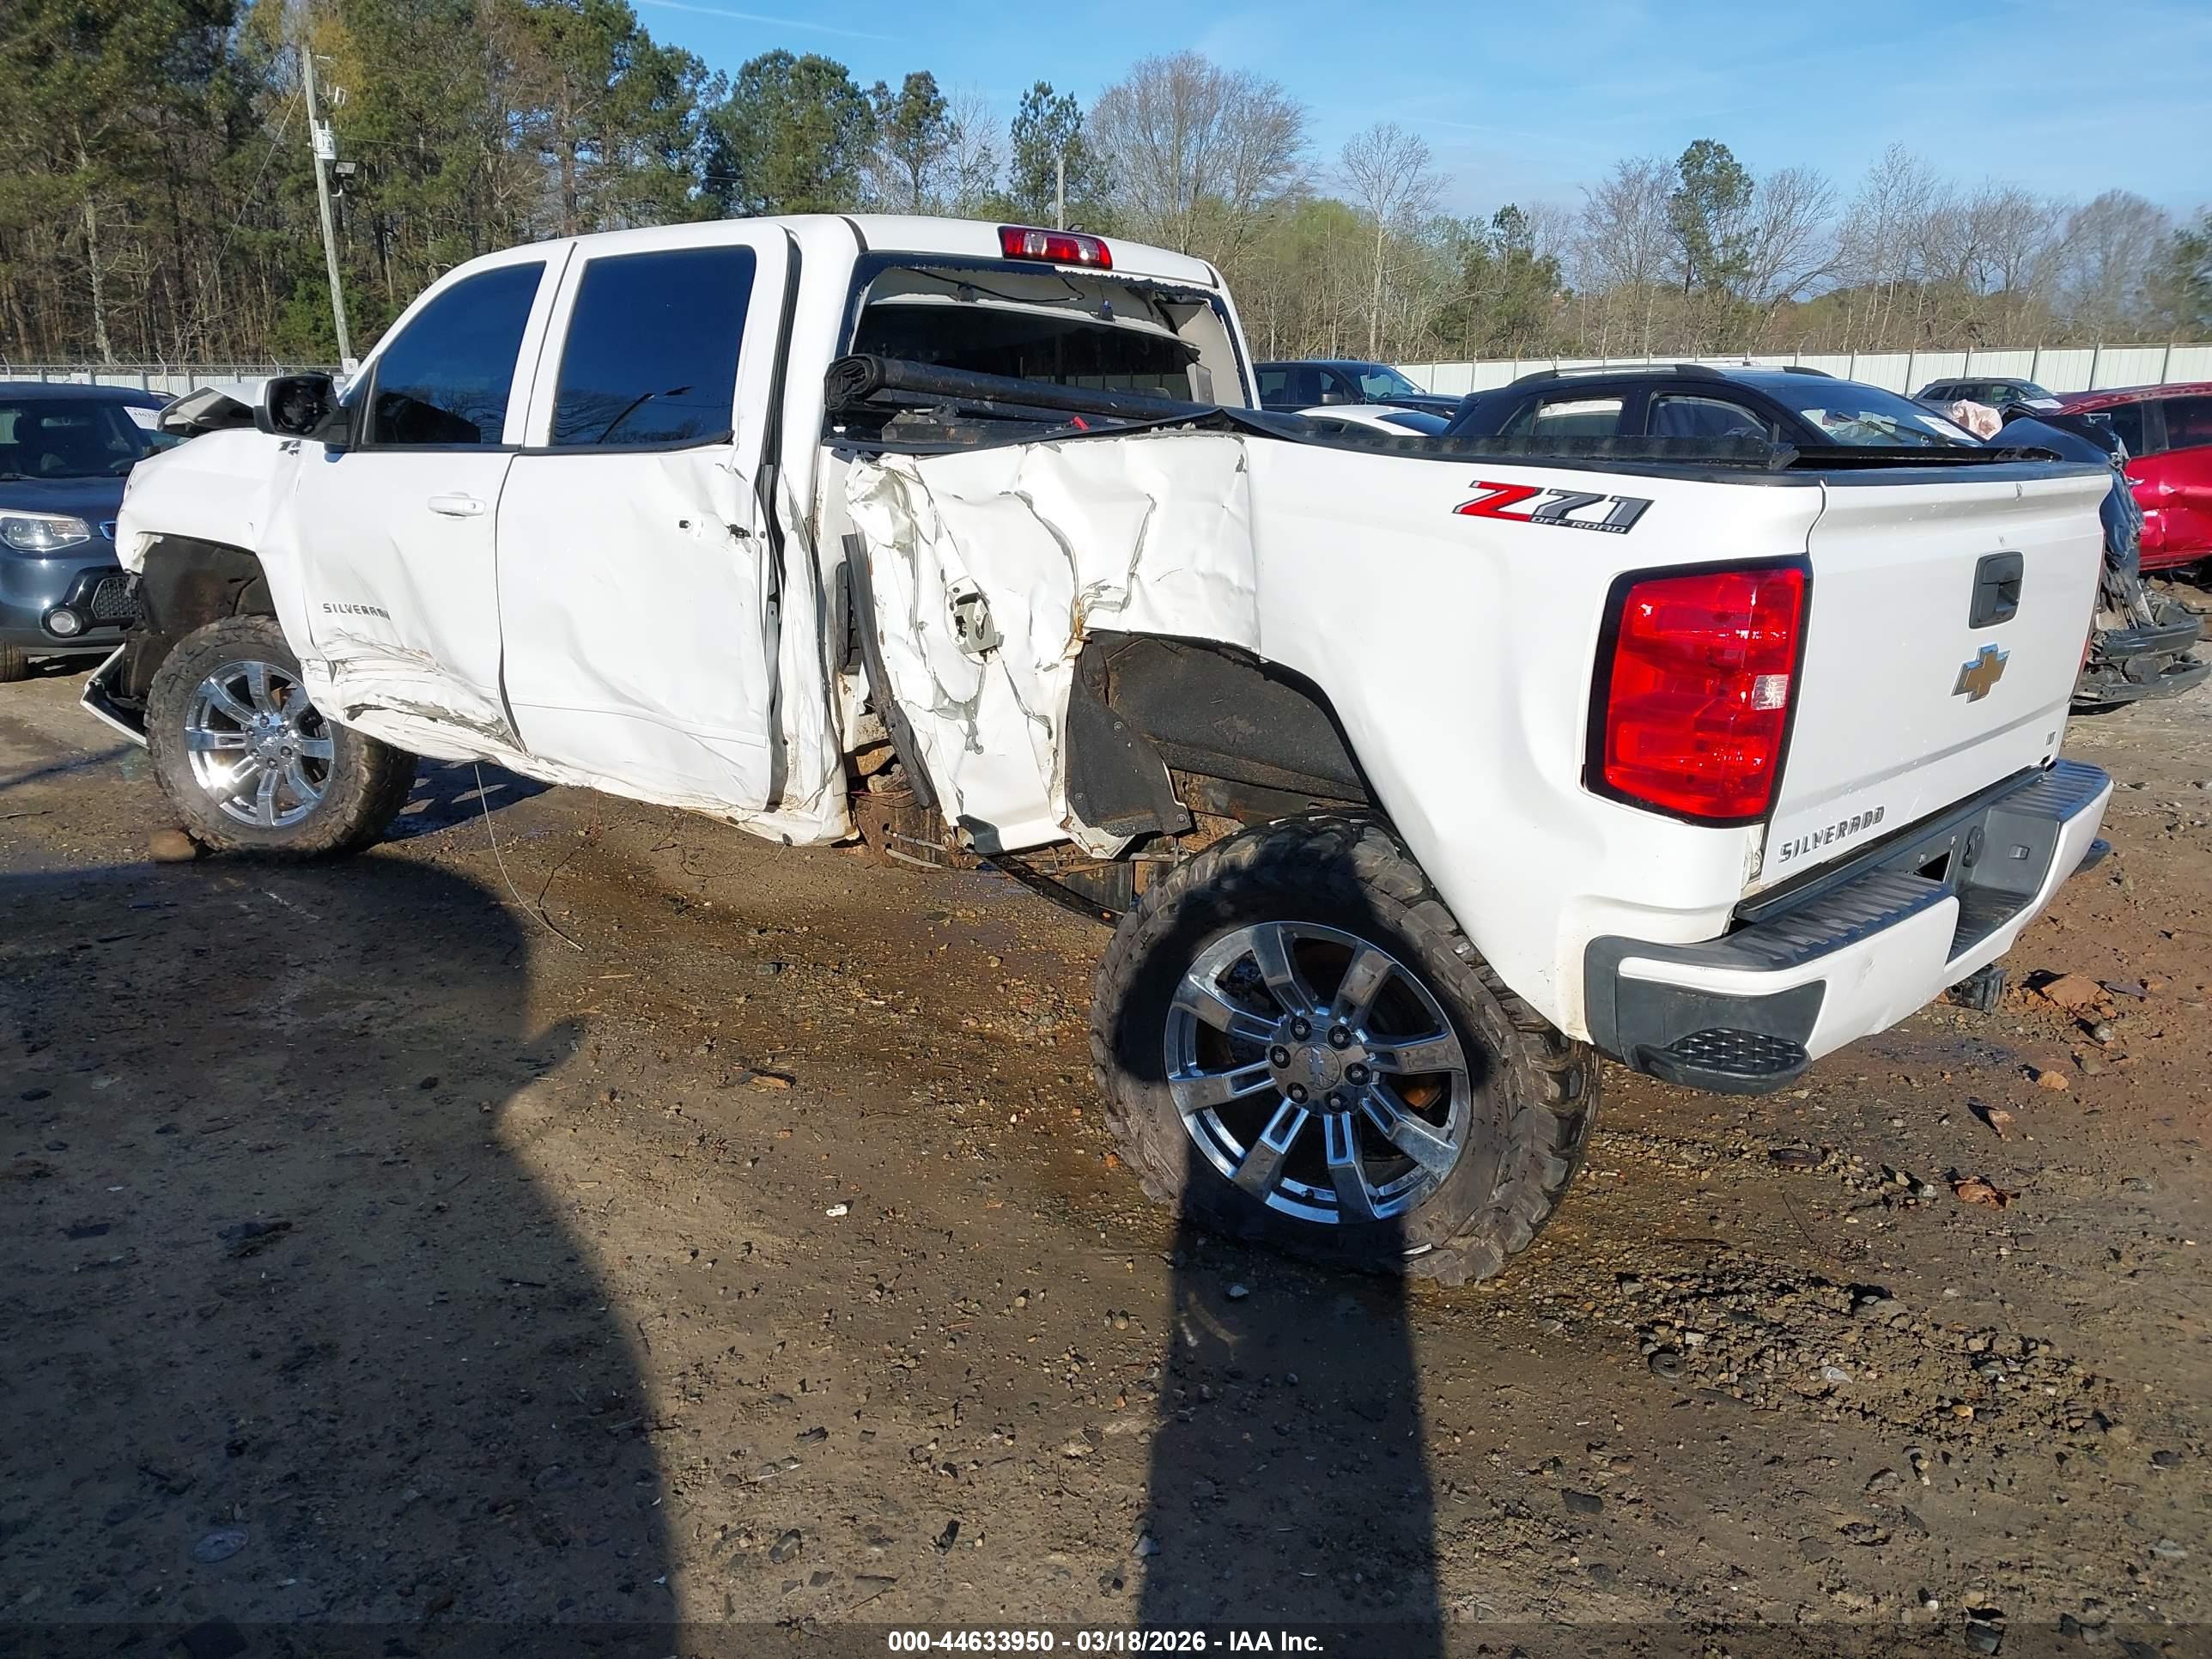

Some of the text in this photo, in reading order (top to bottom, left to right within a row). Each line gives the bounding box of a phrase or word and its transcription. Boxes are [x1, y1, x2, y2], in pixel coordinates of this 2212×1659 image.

[1451, 480, 1656, 532] Z71
[1530, 515, 1626, 533] OFF ROAD
[1778, 805, 1886, 864] SILVERADO
